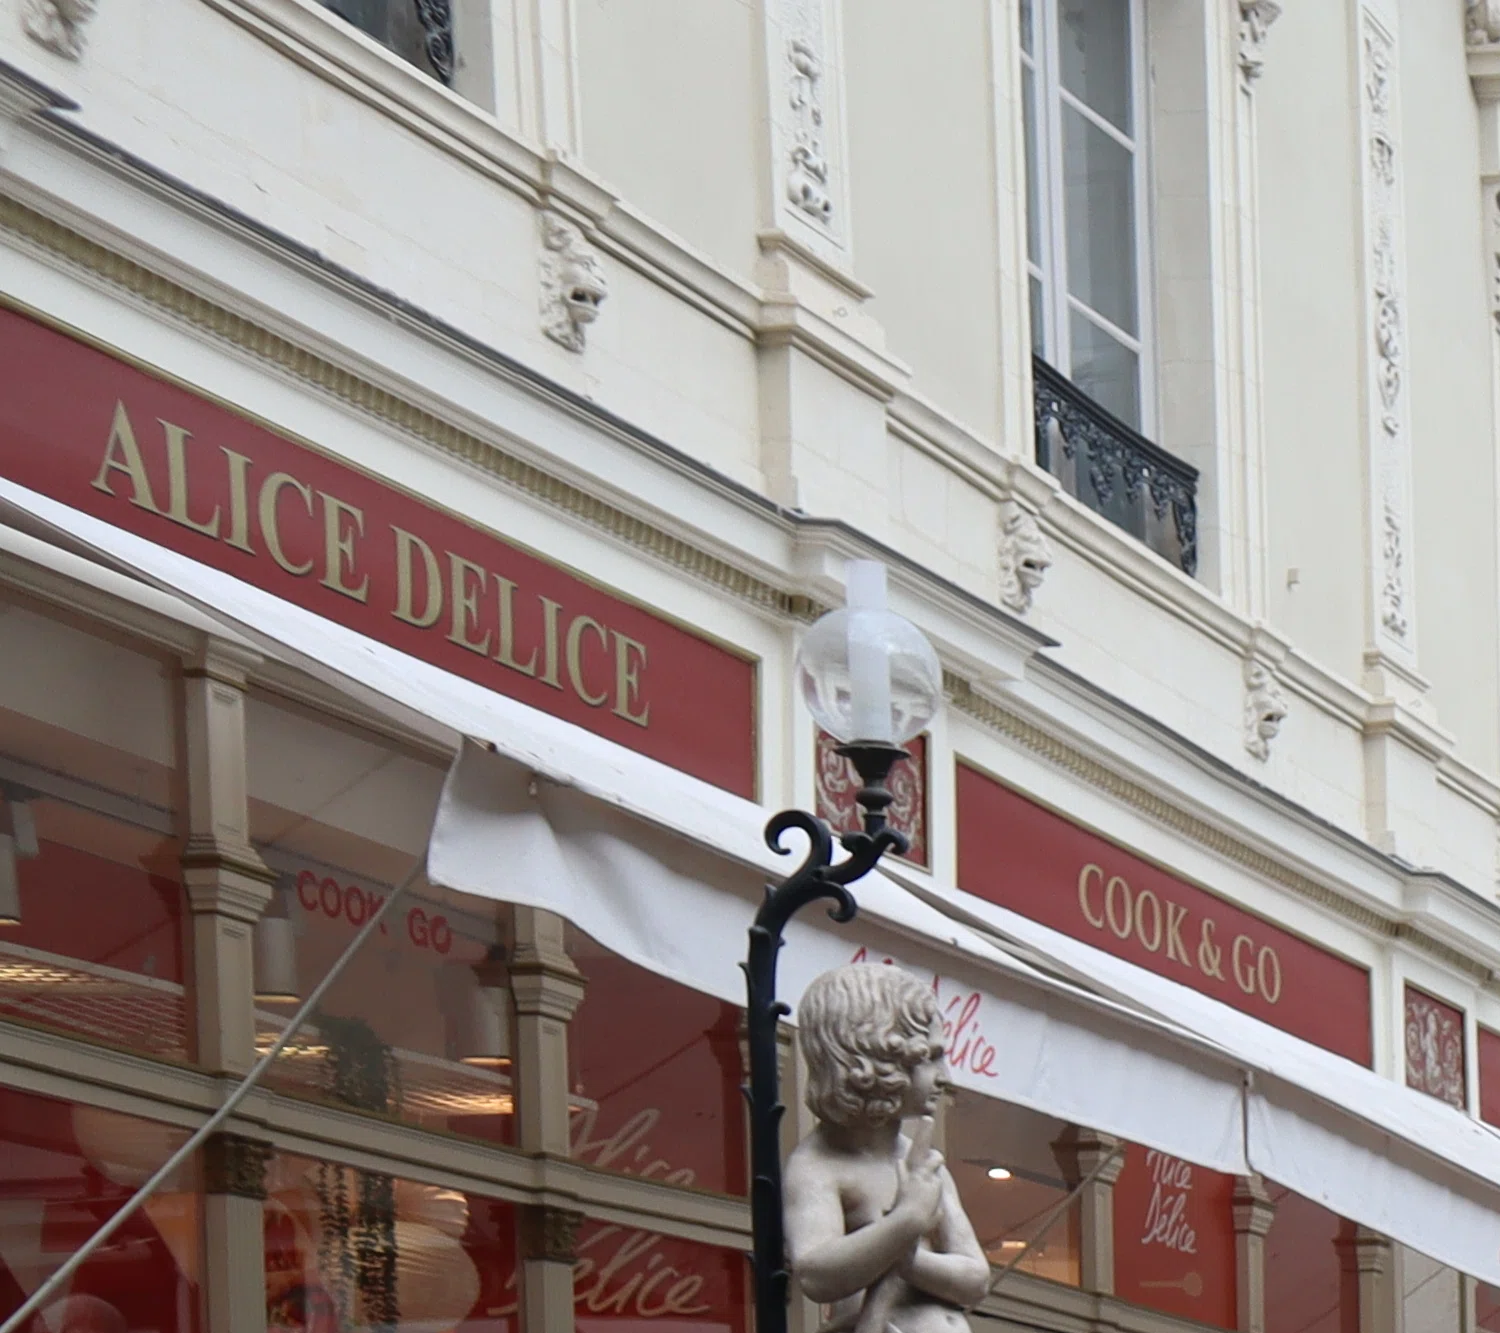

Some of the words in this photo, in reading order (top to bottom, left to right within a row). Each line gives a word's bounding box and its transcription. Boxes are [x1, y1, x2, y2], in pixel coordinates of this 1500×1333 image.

[91, 400, 370, 604] ALICE
[389, 524, 650, 728] DELICE
[407, 907, 452, 954] GO
[1078, 863, 1192, 968] COOK
[1199, 918, 1225, 981] &
[1232, 935, 1281, 1004] GO
[1141, 1182, 1198, 1254] Délice
